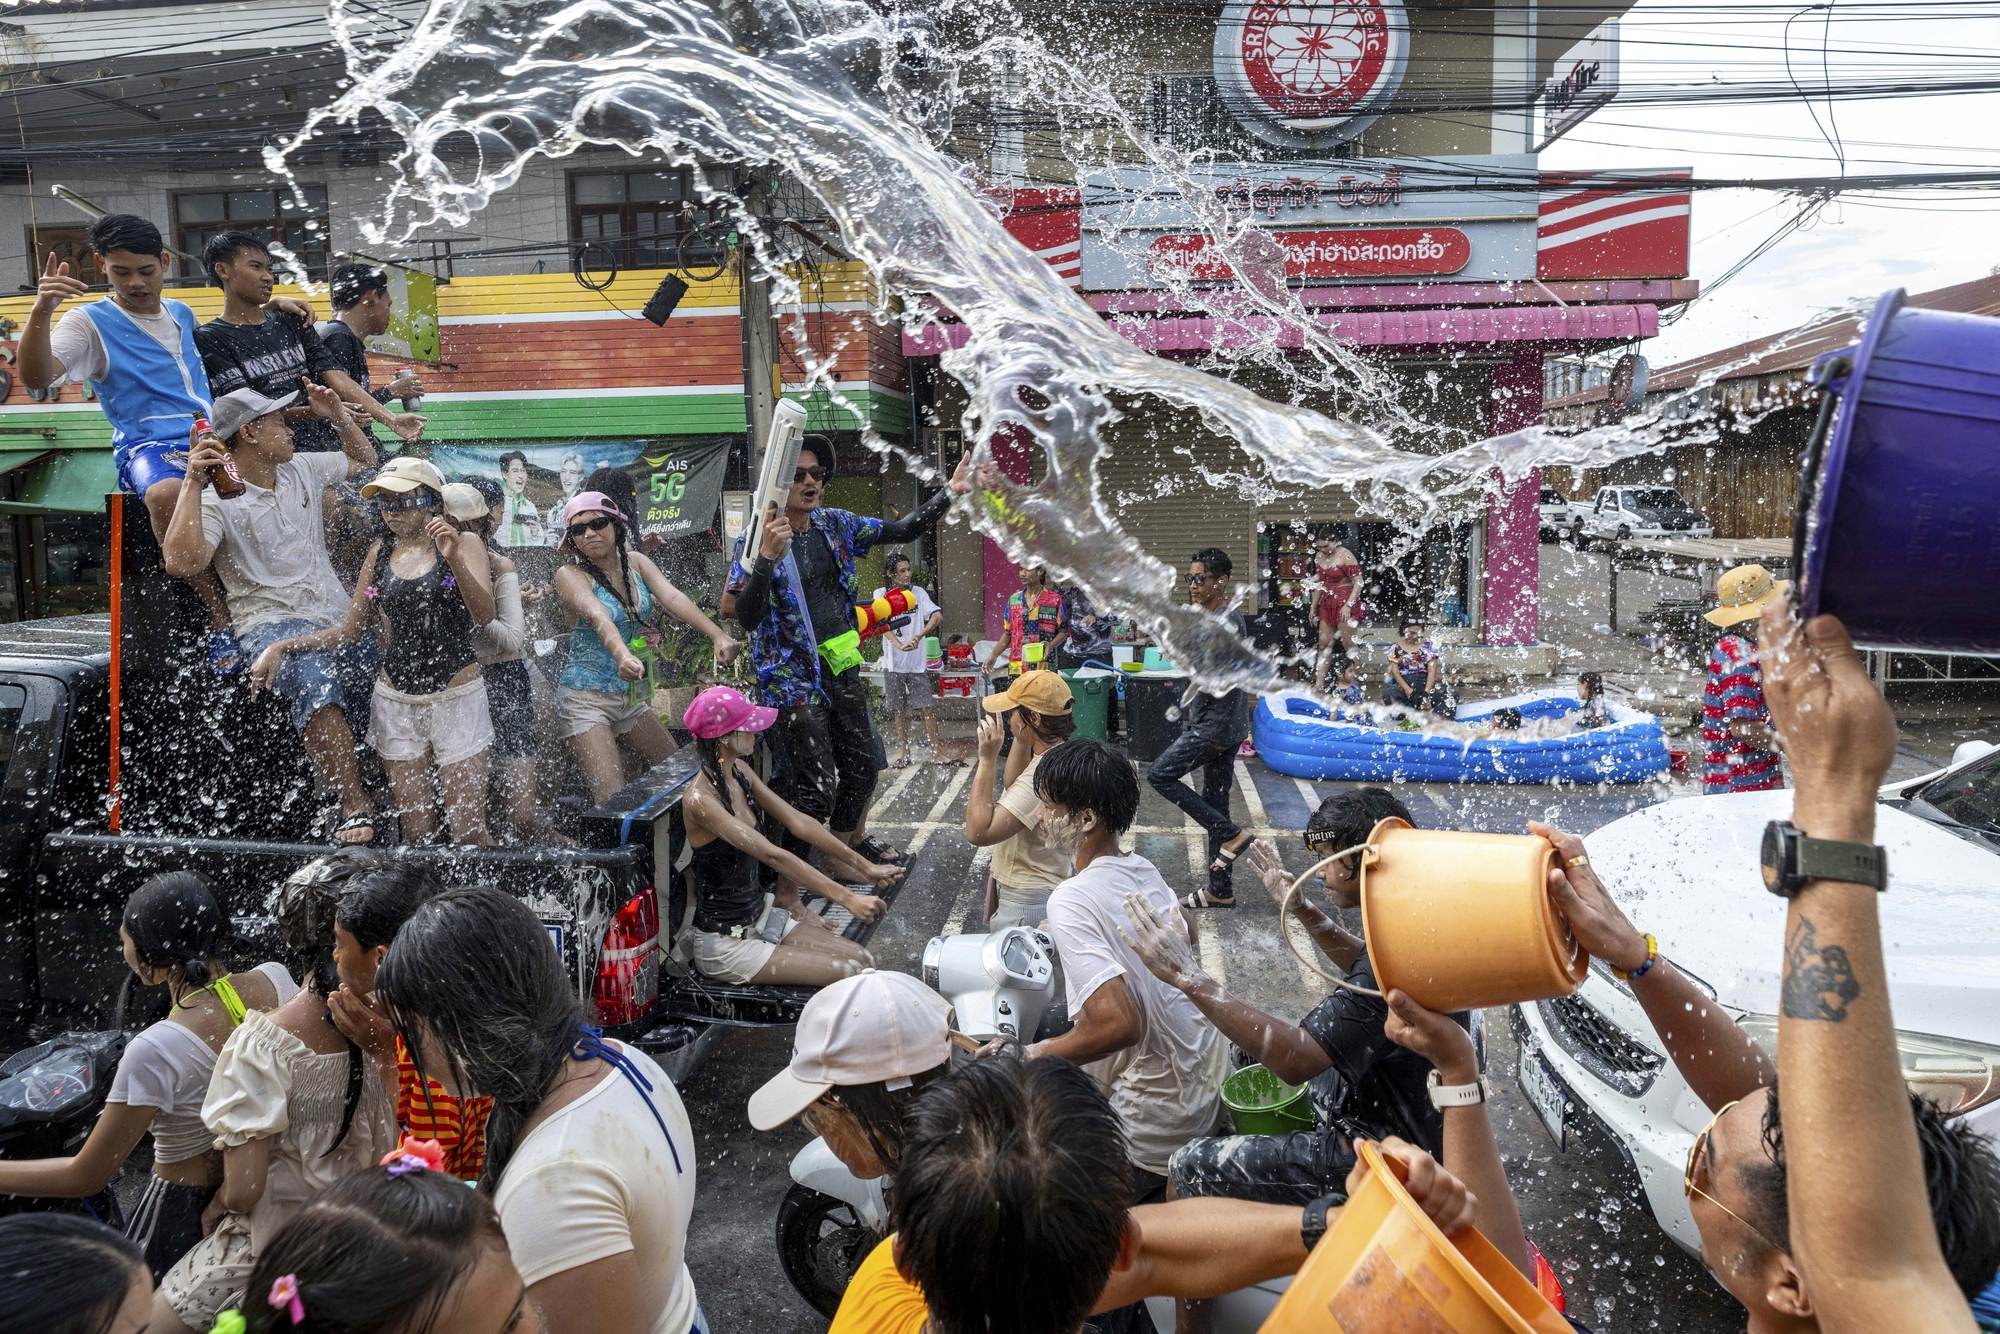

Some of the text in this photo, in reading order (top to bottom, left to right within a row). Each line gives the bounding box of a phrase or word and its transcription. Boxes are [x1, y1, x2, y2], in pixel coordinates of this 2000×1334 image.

[372, 343, 383, 352] AIS
[666, 460, 688, 471] AIS
[649, 472, 686, 504] 5G
[647, 506, 680, 521] ตัวจริง
[1307, 831, 1336, 844] palm
